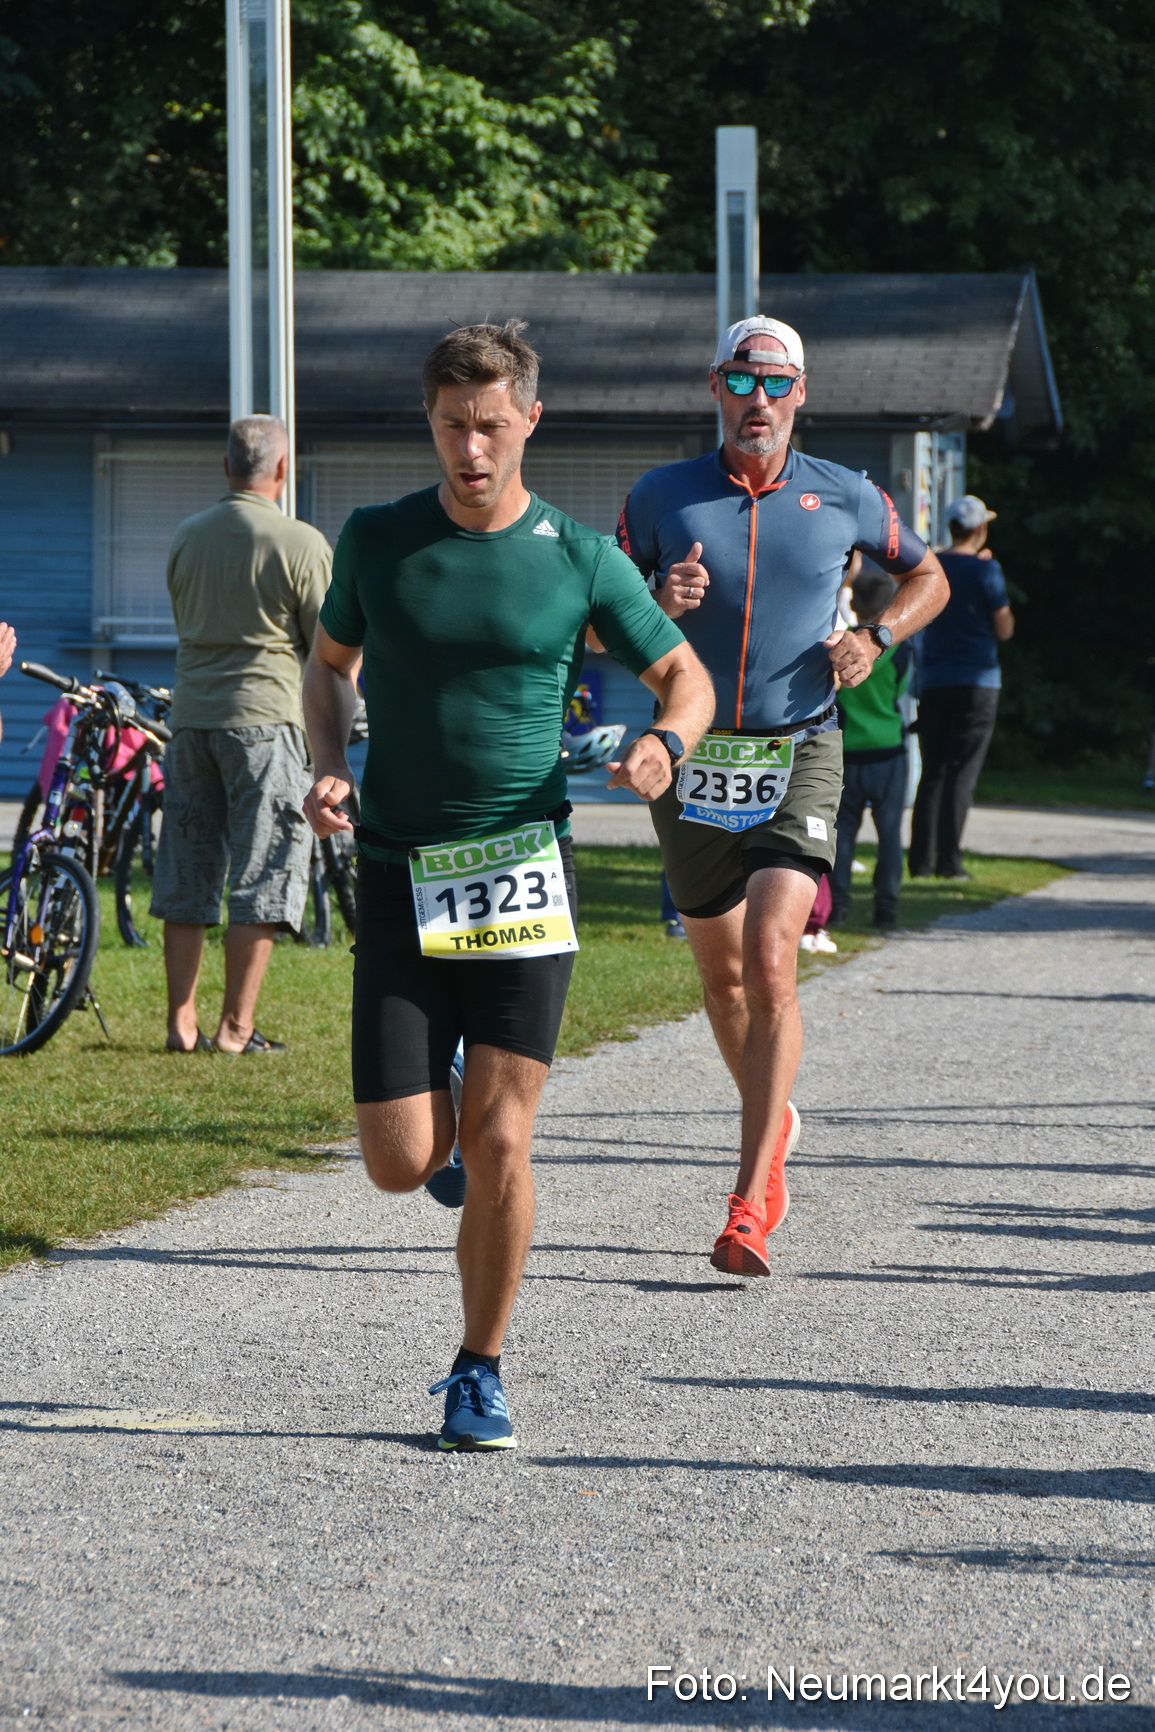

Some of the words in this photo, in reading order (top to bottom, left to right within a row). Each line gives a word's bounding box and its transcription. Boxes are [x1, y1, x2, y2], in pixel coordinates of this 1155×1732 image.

[532, 528, 560, 538] adidas
[873, 483, 899, 559] caste
[692, 741, 781, 763] BOCK
[689, 769, 778, 804] 2336
[422, 829, 549, 876] BOCK
[550, 871, 558, 880] A
[435, 870, 549, 924] 1323
[450, 923, 547, 950] THOMAS
